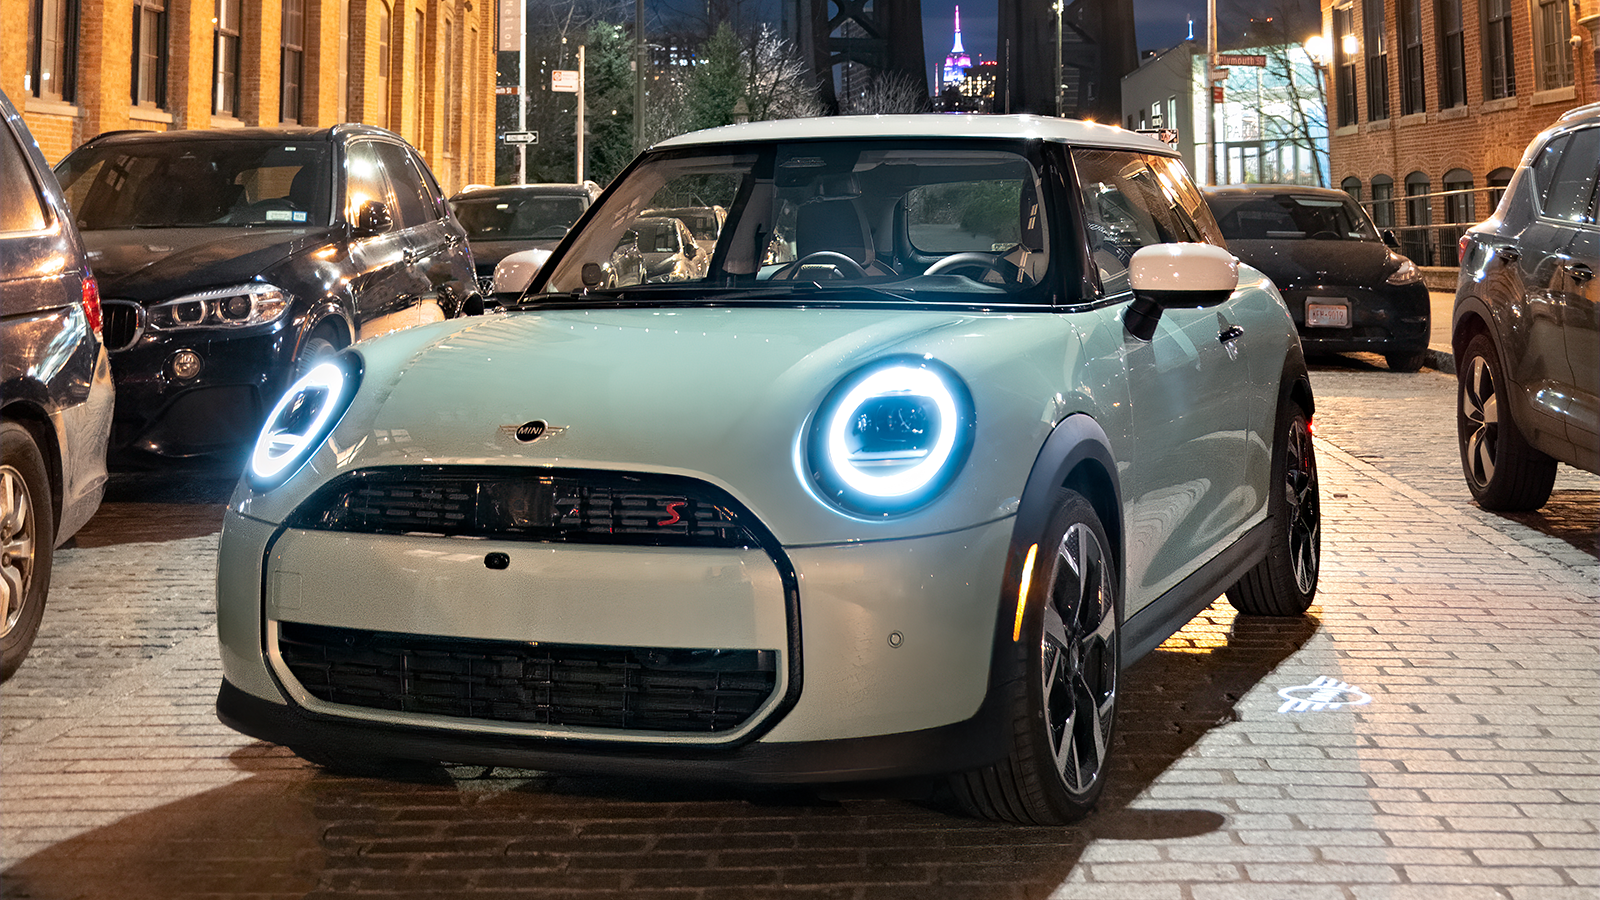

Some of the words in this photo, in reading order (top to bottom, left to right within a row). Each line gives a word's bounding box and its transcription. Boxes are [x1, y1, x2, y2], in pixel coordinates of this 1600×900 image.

[1219, 56, 1255, 66] Plymouth
[518, 426, 543, 435] MINI
[657, 501, 685, 526] S
